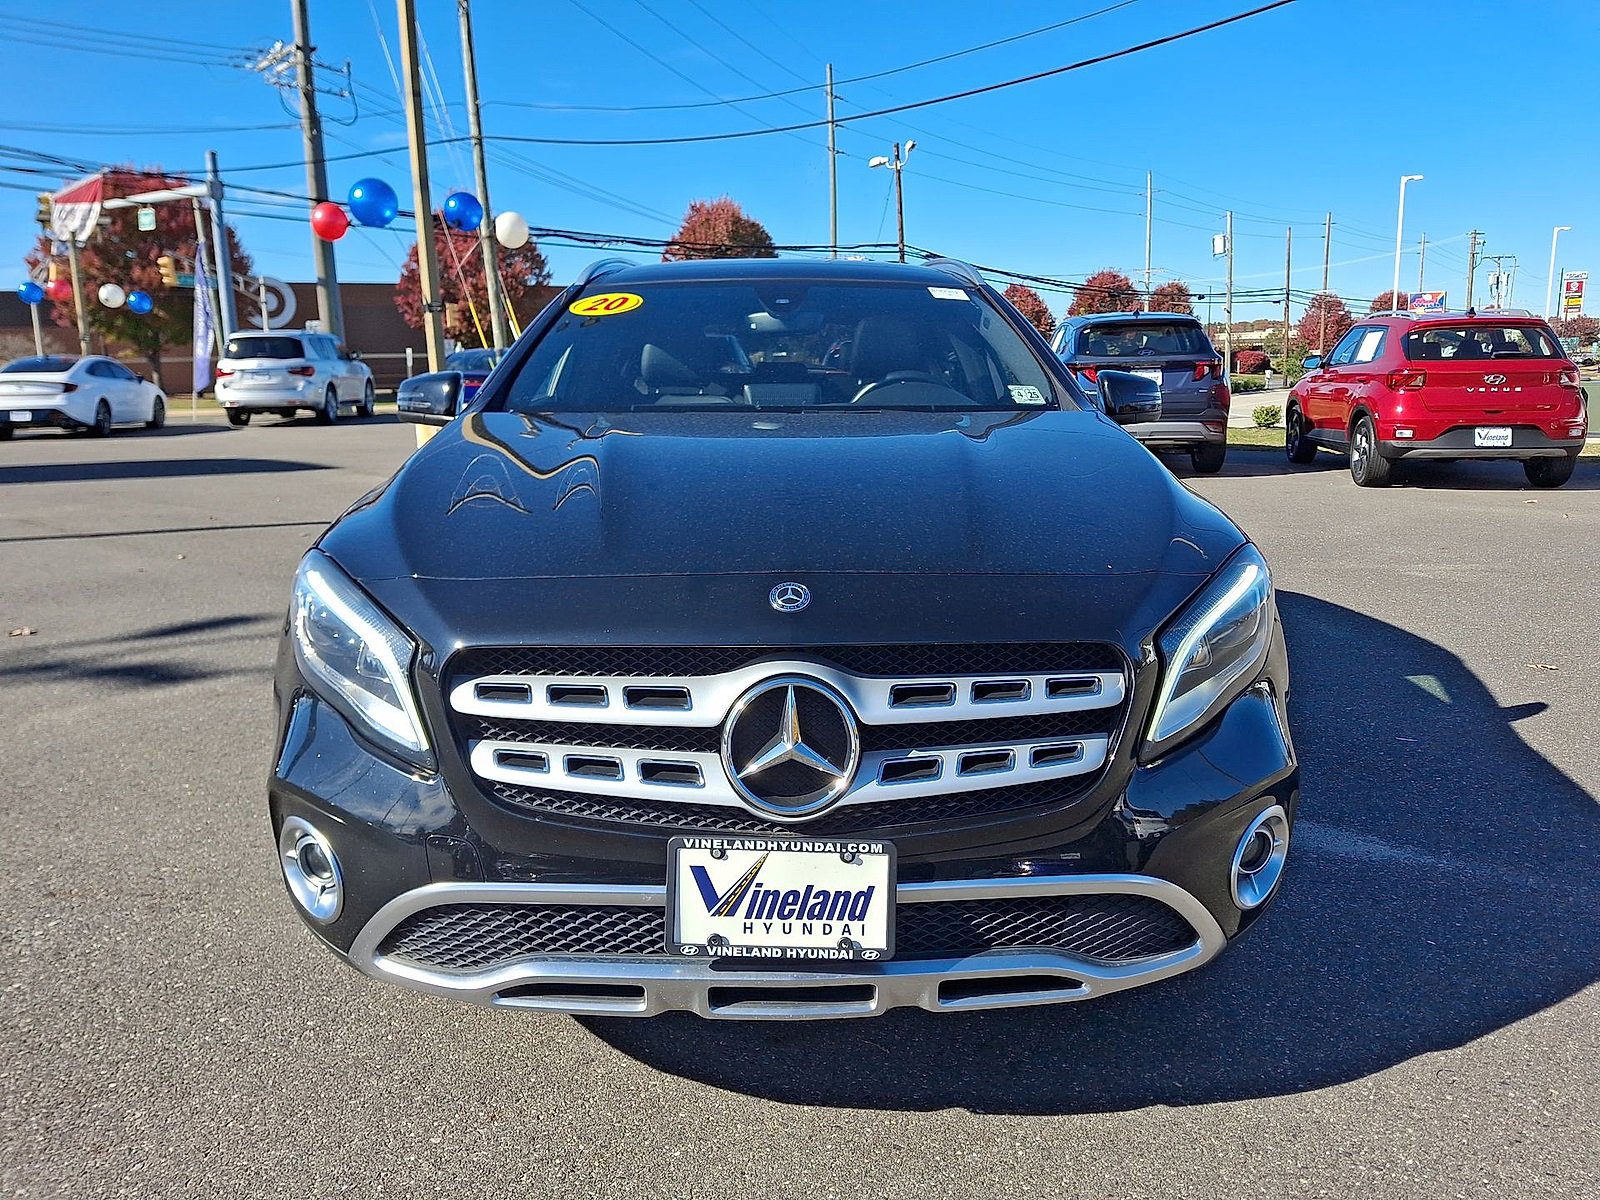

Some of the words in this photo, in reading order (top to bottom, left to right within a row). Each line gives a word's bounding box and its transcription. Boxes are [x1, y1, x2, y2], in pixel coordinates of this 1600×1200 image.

[582, 297, 630, 311] 20
[1028, 391, 1040, 399] 25
[1477, 431, 1510, 441] Vineland
[683, 838, 884, 854] VINELANDHYUNDAI.COM
[689, 851, 876, 922] Vineland
[743, 922, 866, 937] HYUNDAI
[706, 945, 782, 958] VINELAND
[786, 948, 854, 960] HYUNDAI
